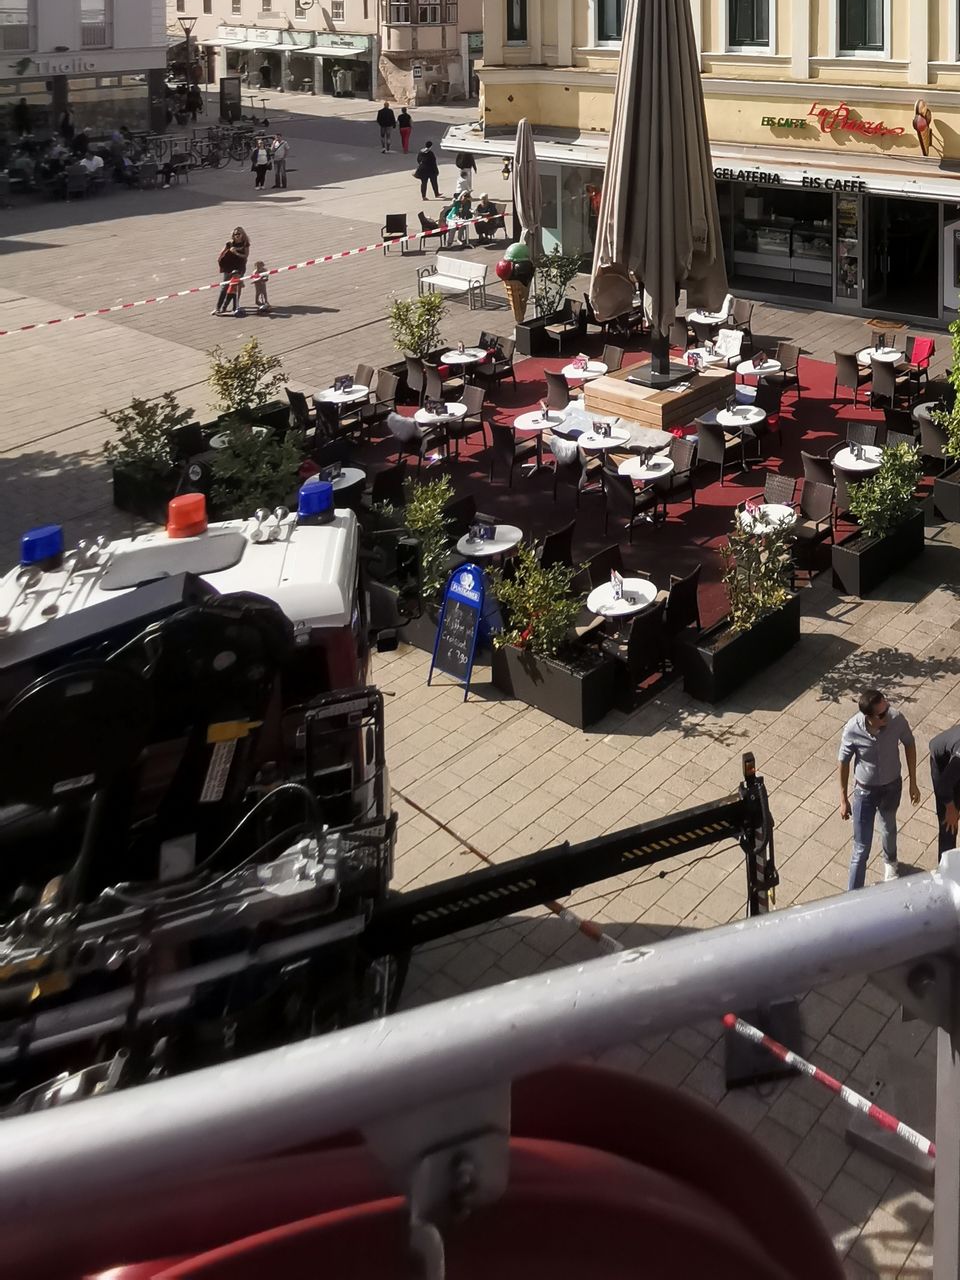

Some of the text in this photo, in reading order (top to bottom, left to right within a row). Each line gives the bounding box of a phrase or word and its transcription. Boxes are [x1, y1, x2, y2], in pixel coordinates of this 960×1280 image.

[761, 116, 777, 128] EIS
[713, 167, 867, 192] GELATERIA EIS CAFFE
